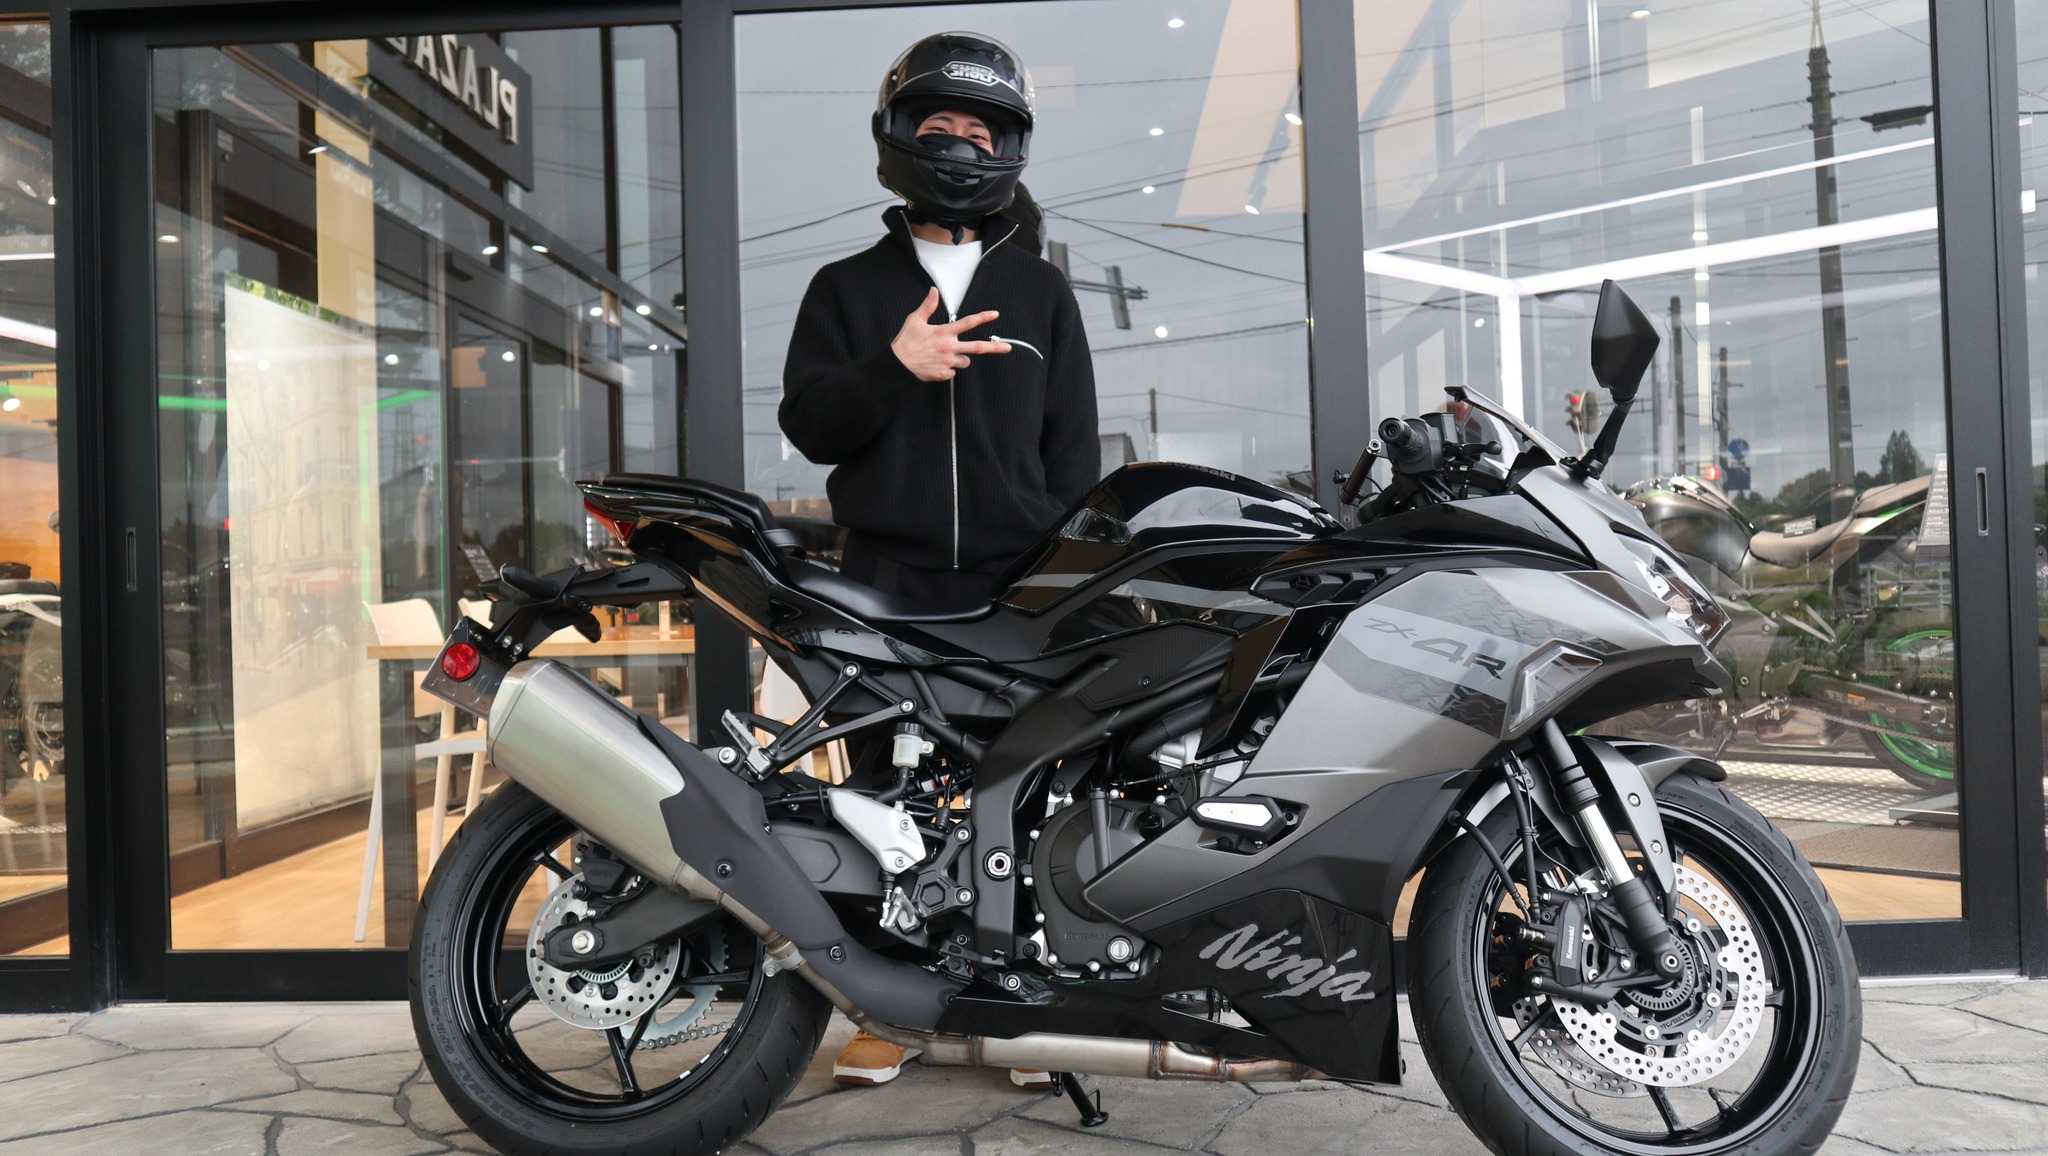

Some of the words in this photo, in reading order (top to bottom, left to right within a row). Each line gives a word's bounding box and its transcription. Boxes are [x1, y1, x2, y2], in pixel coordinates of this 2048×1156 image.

[949, 64, 993, 83] SHOEI
[1565, 925, 1575, 960] Kawasaki
[1199, 923, 1376, 1002] Ninja
